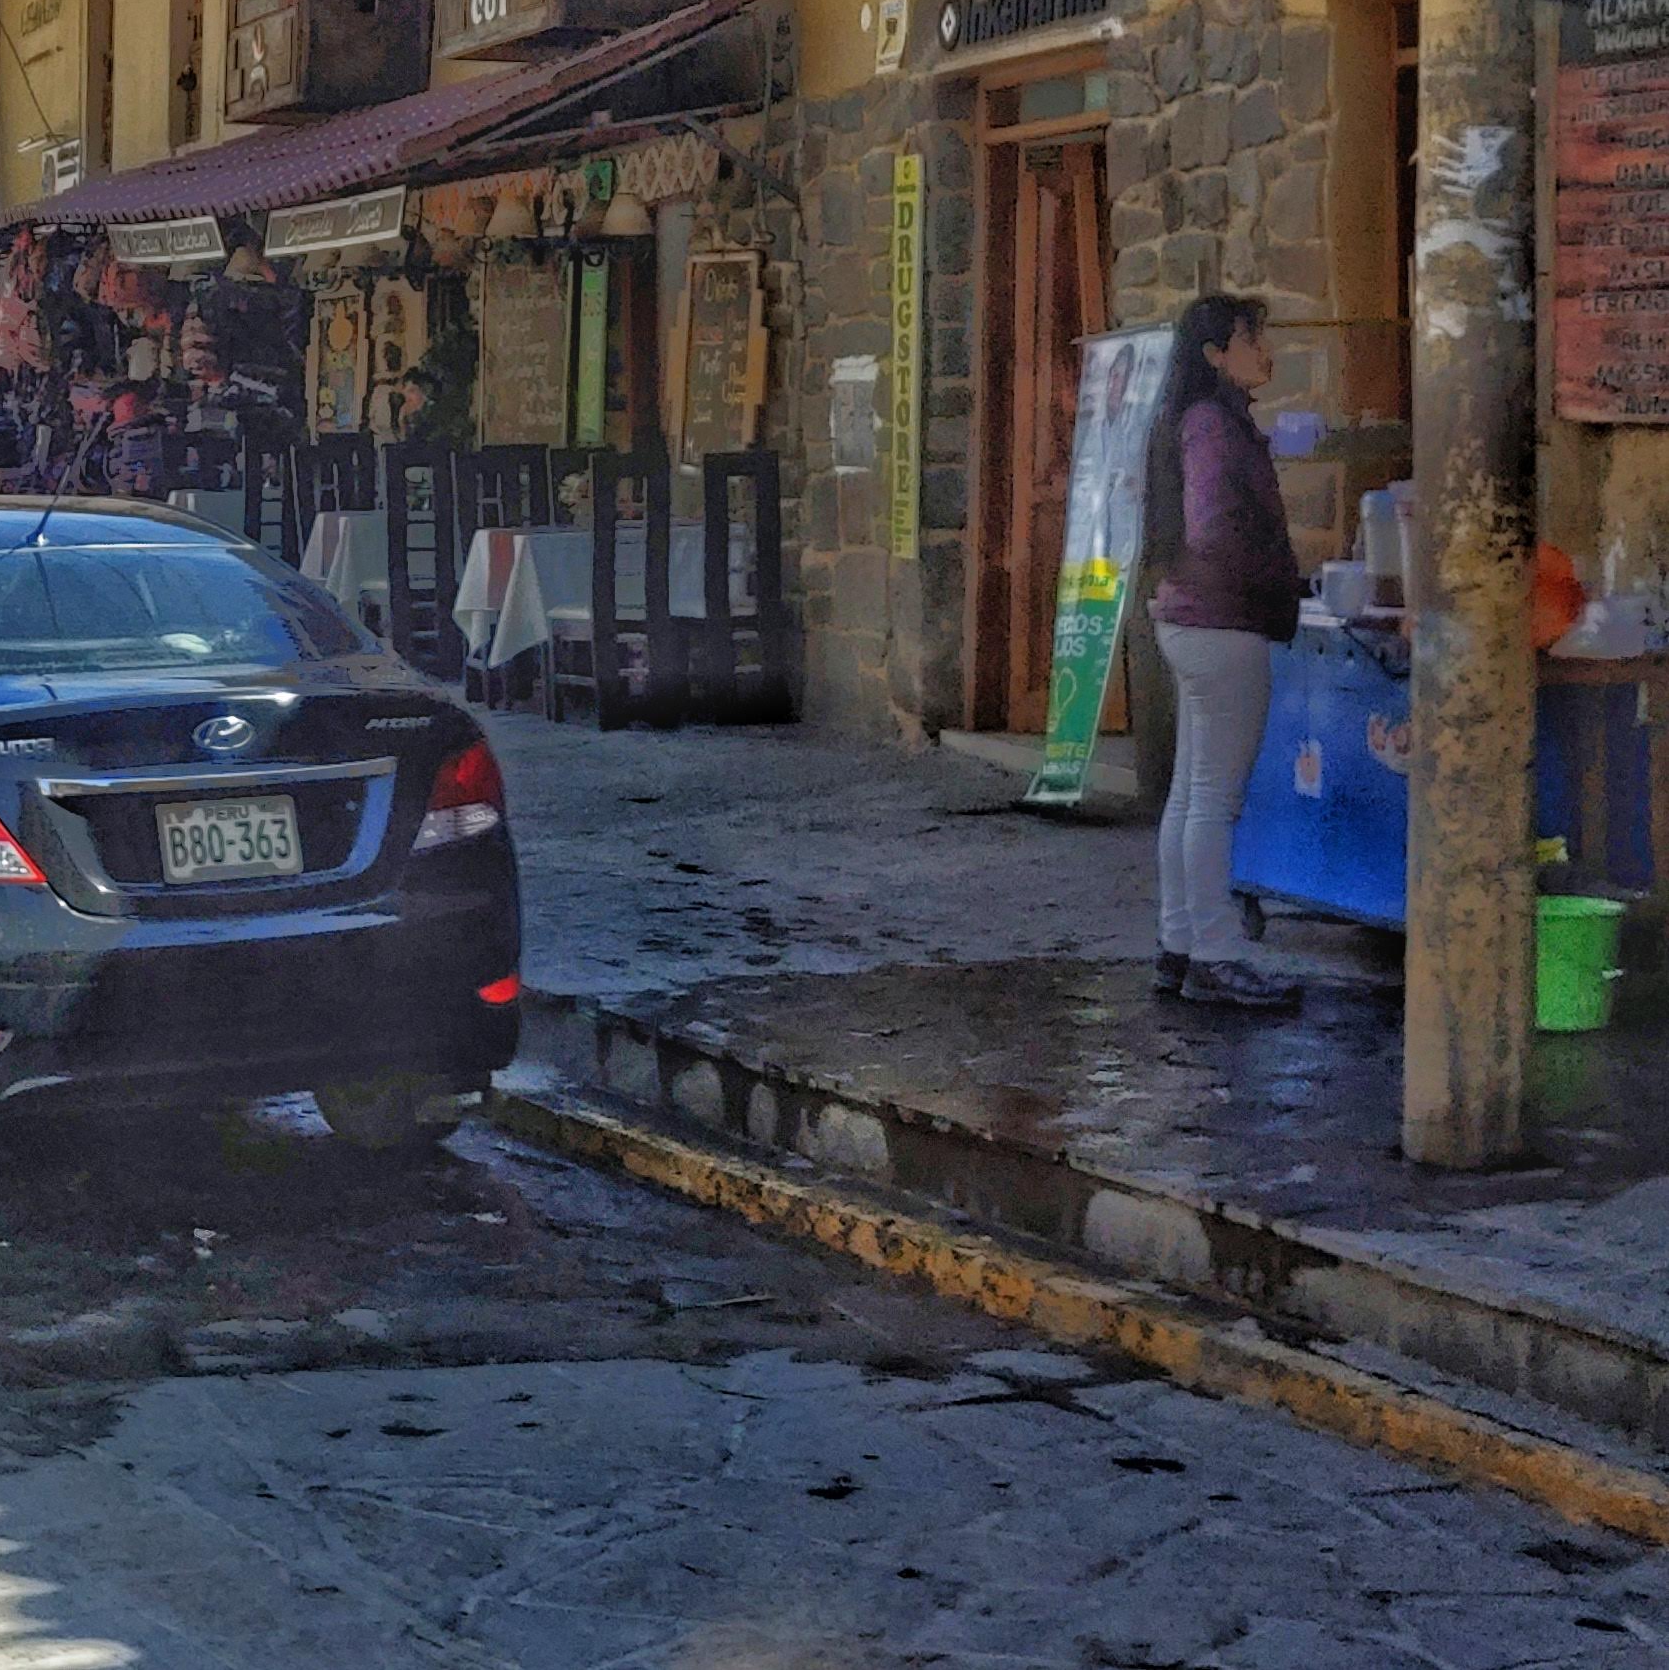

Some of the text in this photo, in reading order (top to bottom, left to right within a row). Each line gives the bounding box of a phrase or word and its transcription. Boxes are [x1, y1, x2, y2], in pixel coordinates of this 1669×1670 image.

[896, 201, 915, 493] DRUGSTORE
[204, 805, 250, 821] PERU
[169, 819, 291, 868] B80-363
